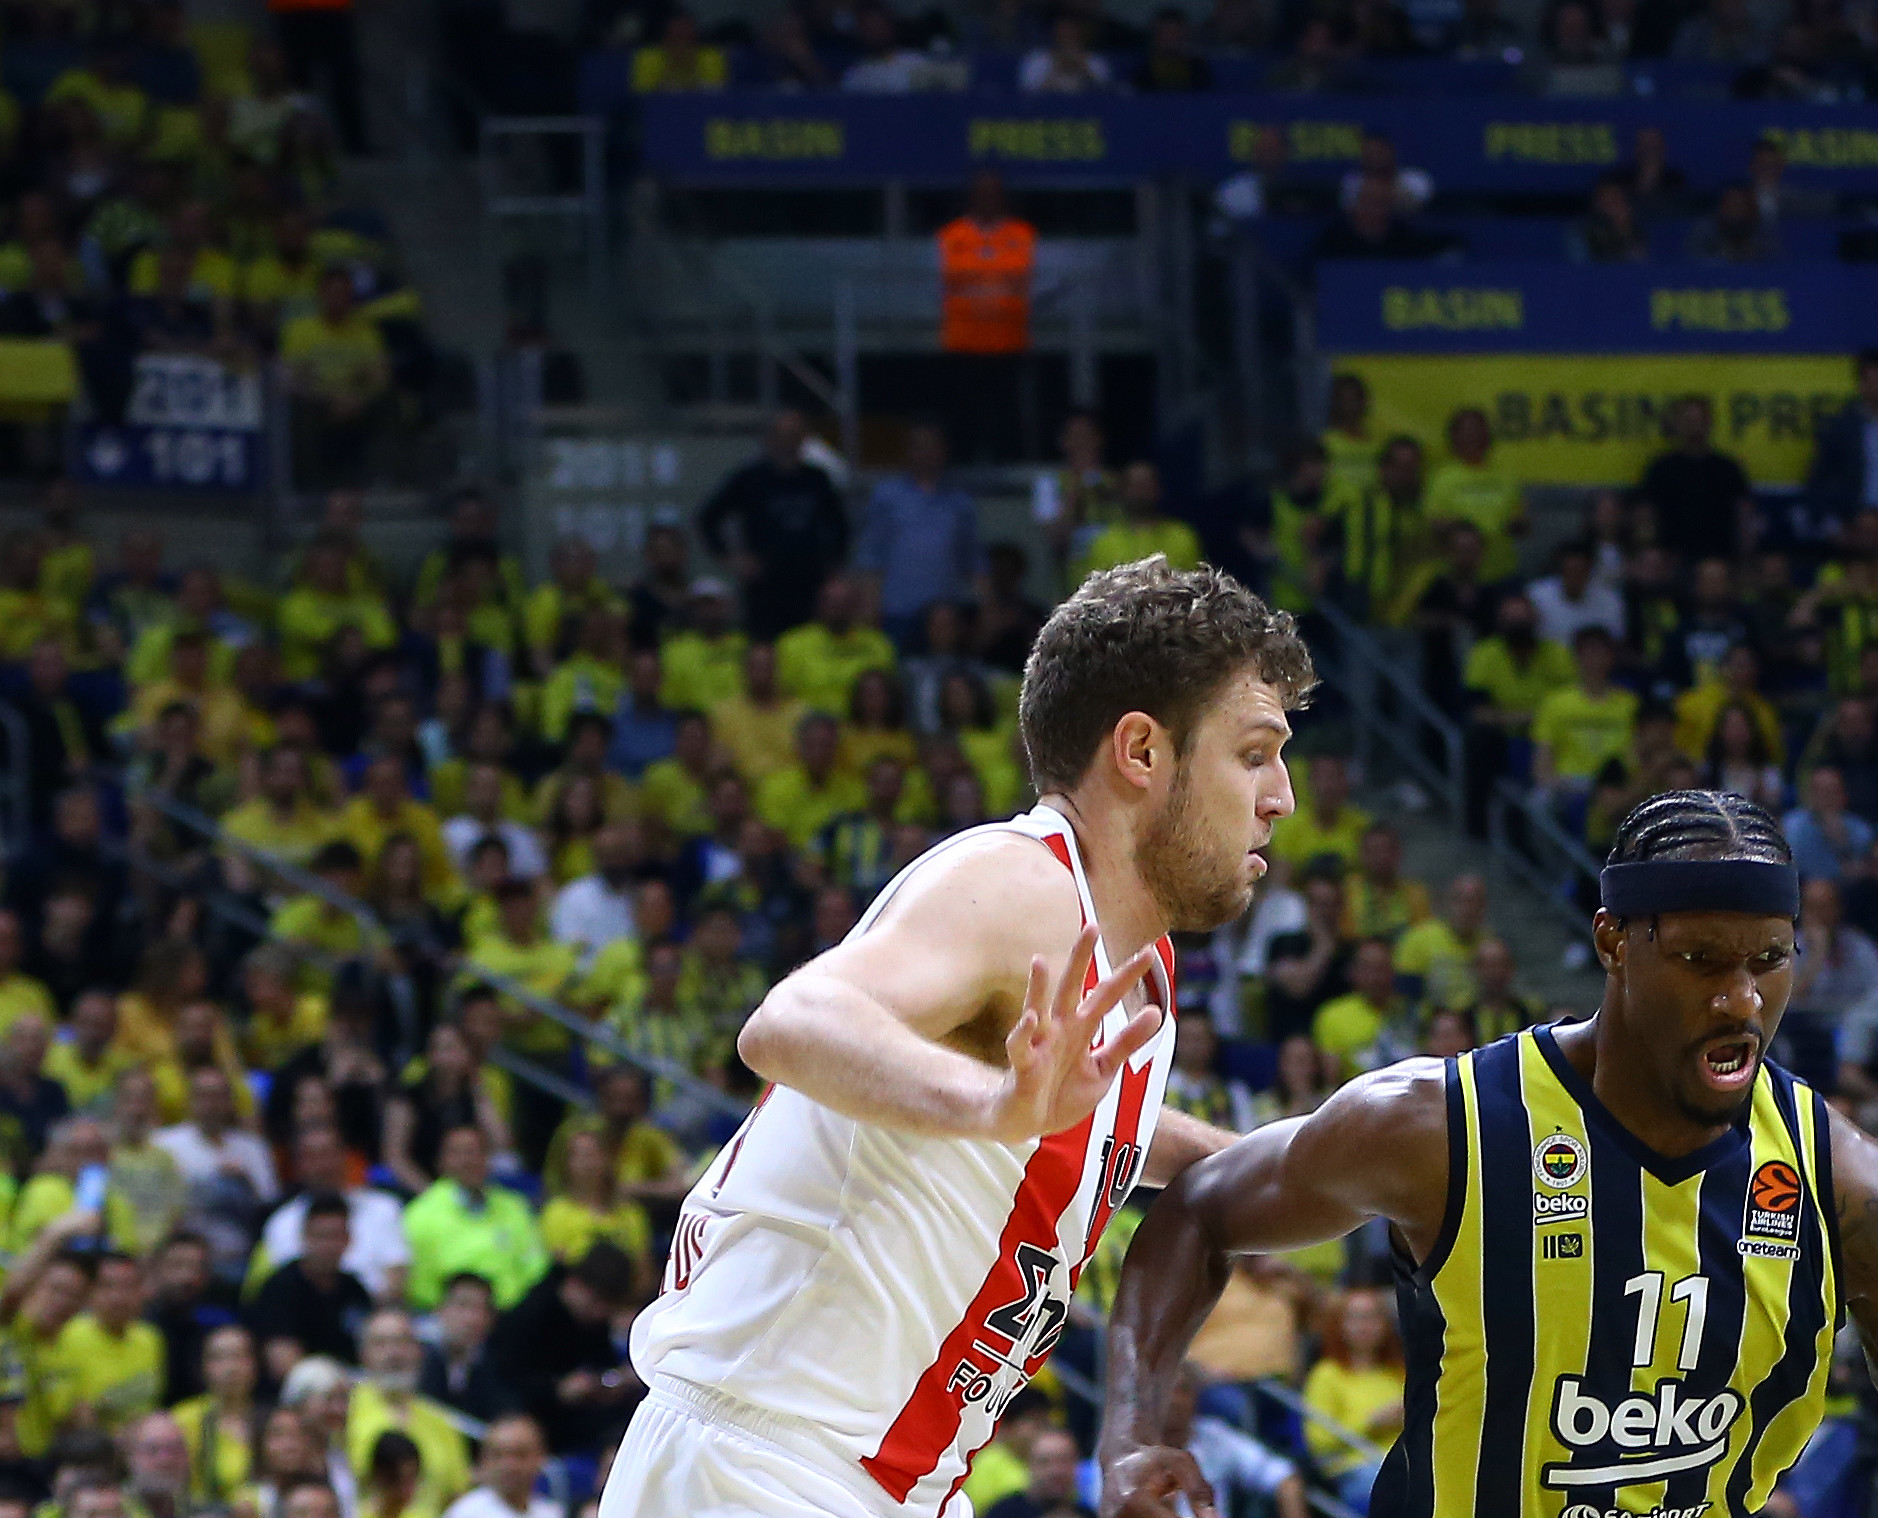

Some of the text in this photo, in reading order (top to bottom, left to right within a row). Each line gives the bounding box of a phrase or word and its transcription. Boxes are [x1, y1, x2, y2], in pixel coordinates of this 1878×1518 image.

[704, 121, 843, 159] BASIN
[969, 120, 1106, 160] PRESS
[1228, 121, 1362, 160] BSIN
[1485, 122, 1617, 164] PRESS
[1381, 286, 1524, 331] BASIN
[1650, 288, 1791, 333] PRESS
[1535, 1193, 1587, 1213] beko
[1751, 1209, 1795, 1222] TURKISH
[1738, 1241, 1799, 1259] oneteam
[1624, 1273, 1709, 1370] 11
[1556, 1380, 1743, 1447] beko
